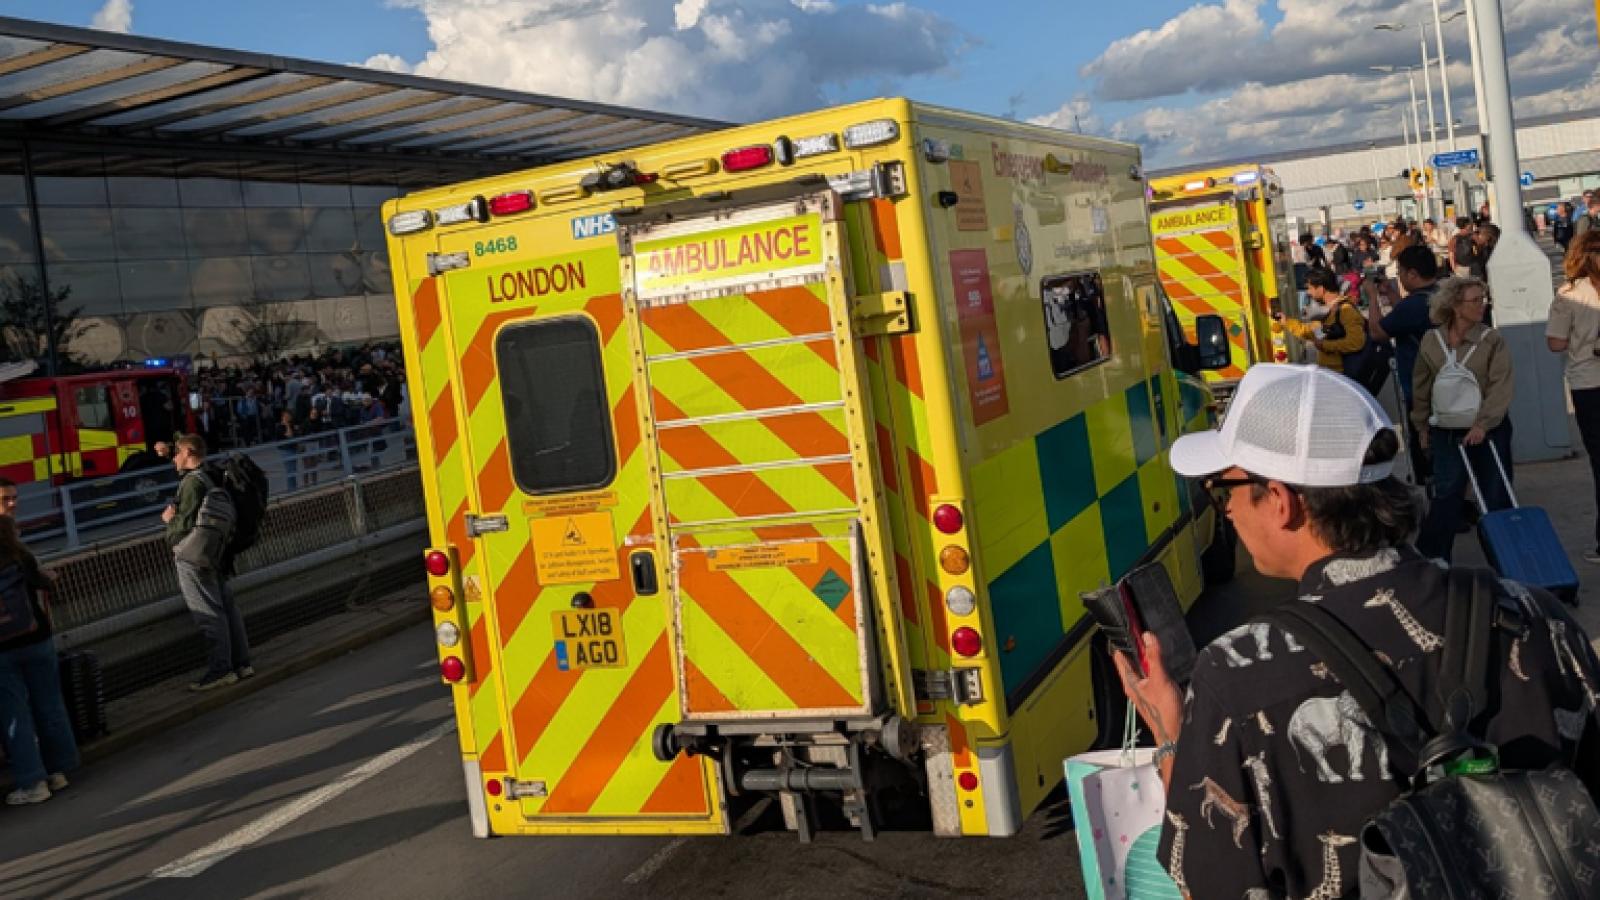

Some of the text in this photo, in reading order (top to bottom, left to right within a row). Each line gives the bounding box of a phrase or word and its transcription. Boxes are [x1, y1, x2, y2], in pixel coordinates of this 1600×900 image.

[573, 214, 616, 239] NHS
[1157, 206, 1227, 230] AMBULANCE
[474, 234, 518, 257] 8468
[649, 224, 812, 277] AMBULANCE
[487, 259, 586, 303] LONDON
[122, 405, 137, 418] 10
[561, 611, 613, 638] LX18
[576, 640, 618, 665] AGO
